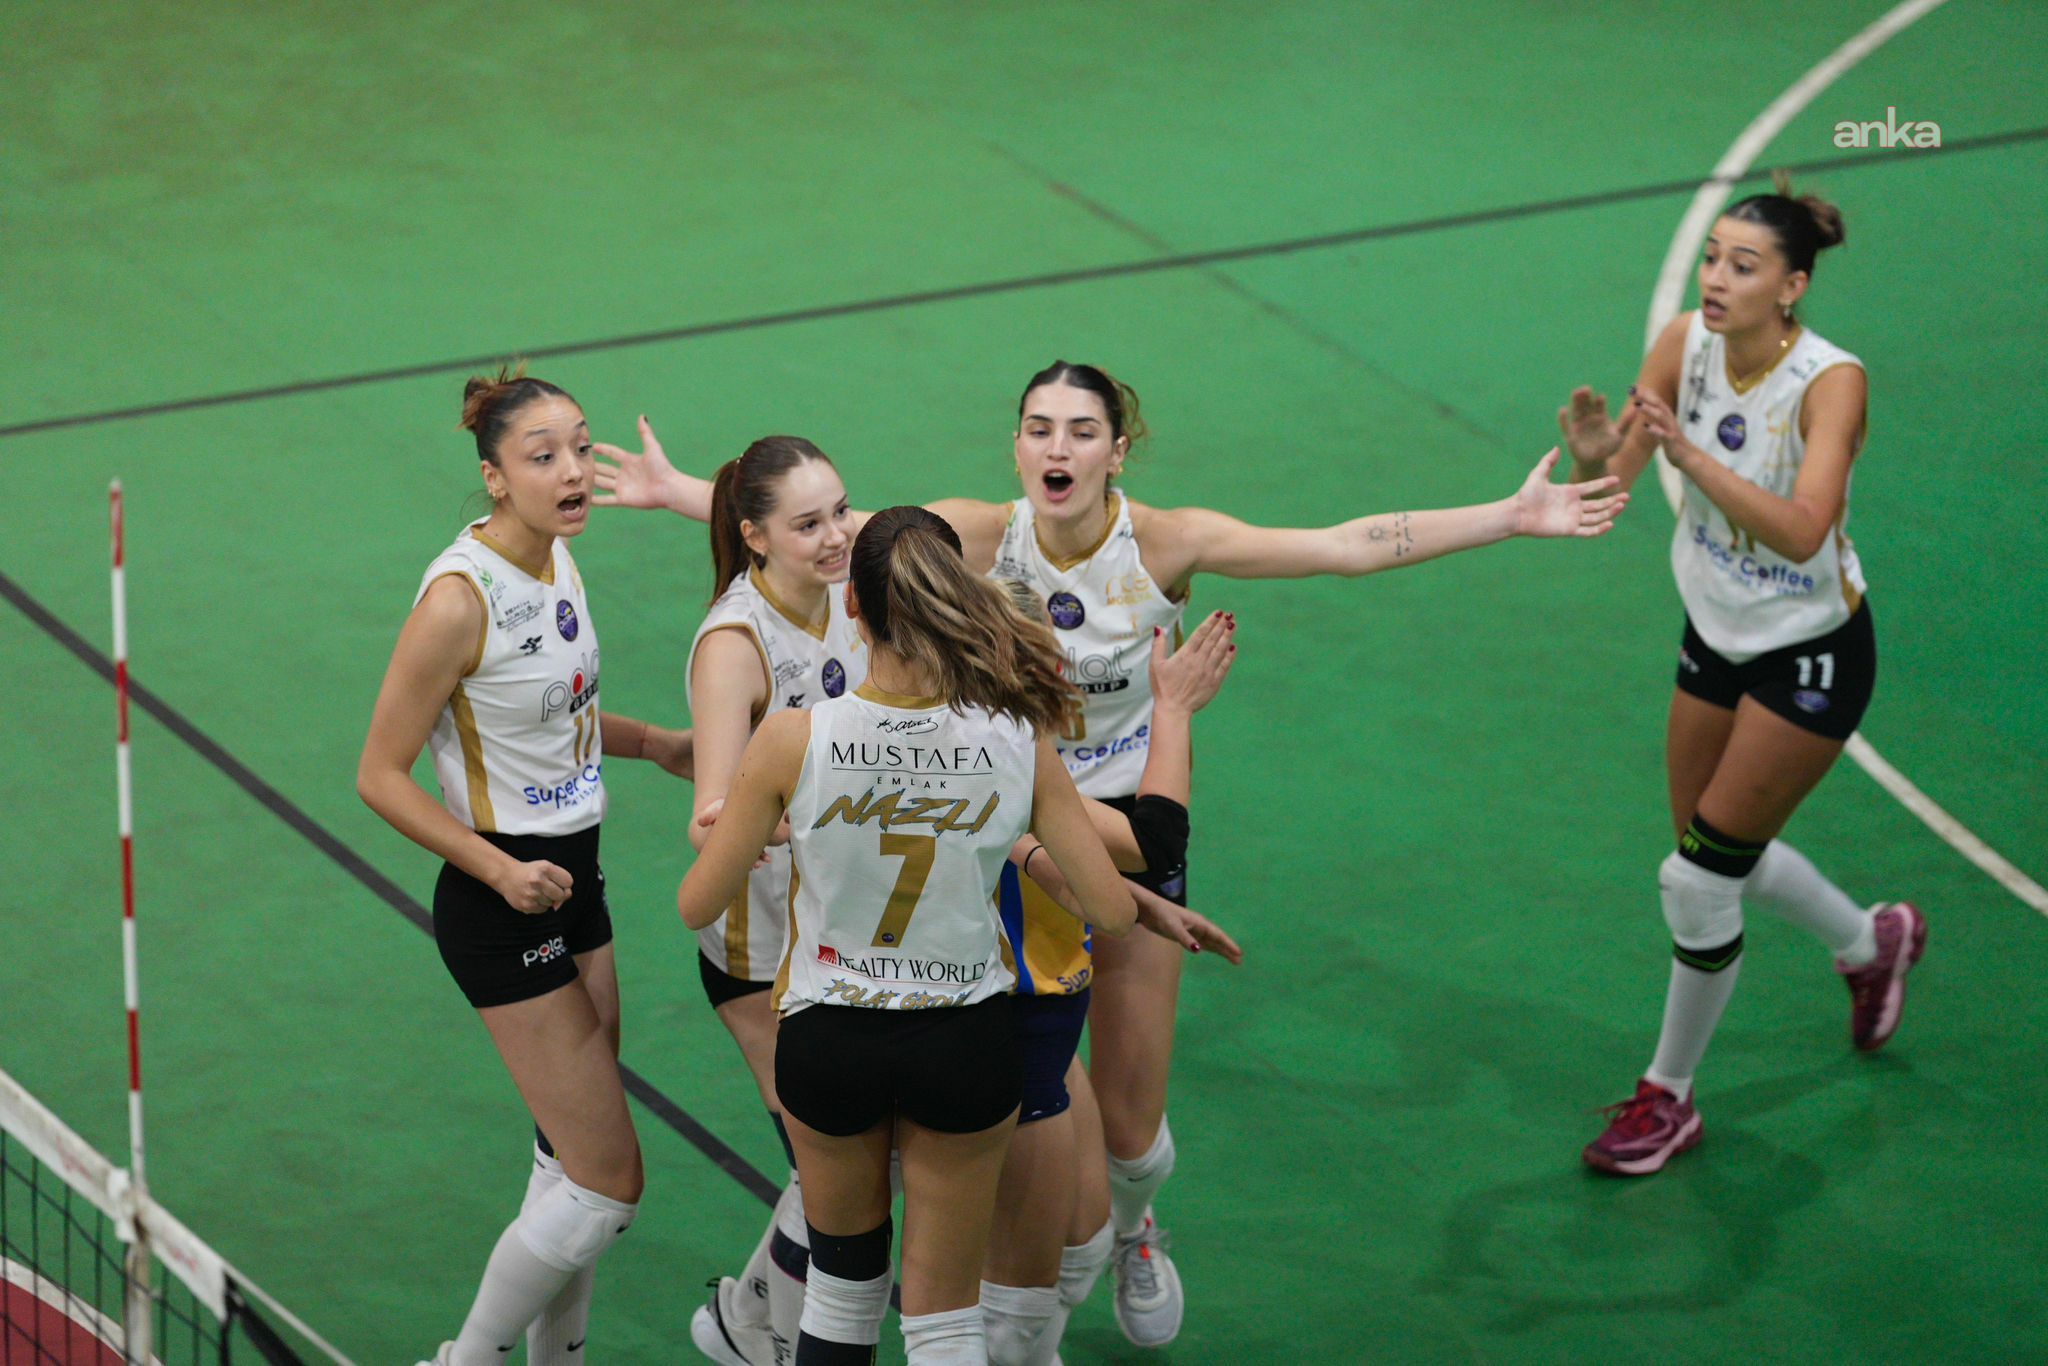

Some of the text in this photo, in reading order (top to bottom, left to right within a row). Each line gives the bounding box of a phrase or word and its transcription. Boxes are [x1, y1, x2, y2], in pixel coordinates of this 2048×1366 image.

[1795, 652, 1835, 690] 11
[832, 741, 993, 770] MUSTAFA
[523, 776, 579, 809] Super
[877, 776, 948, 790] EMLAK
[870, 833, 936, 948] 7
[909, 959, 989, 983] WORLD
